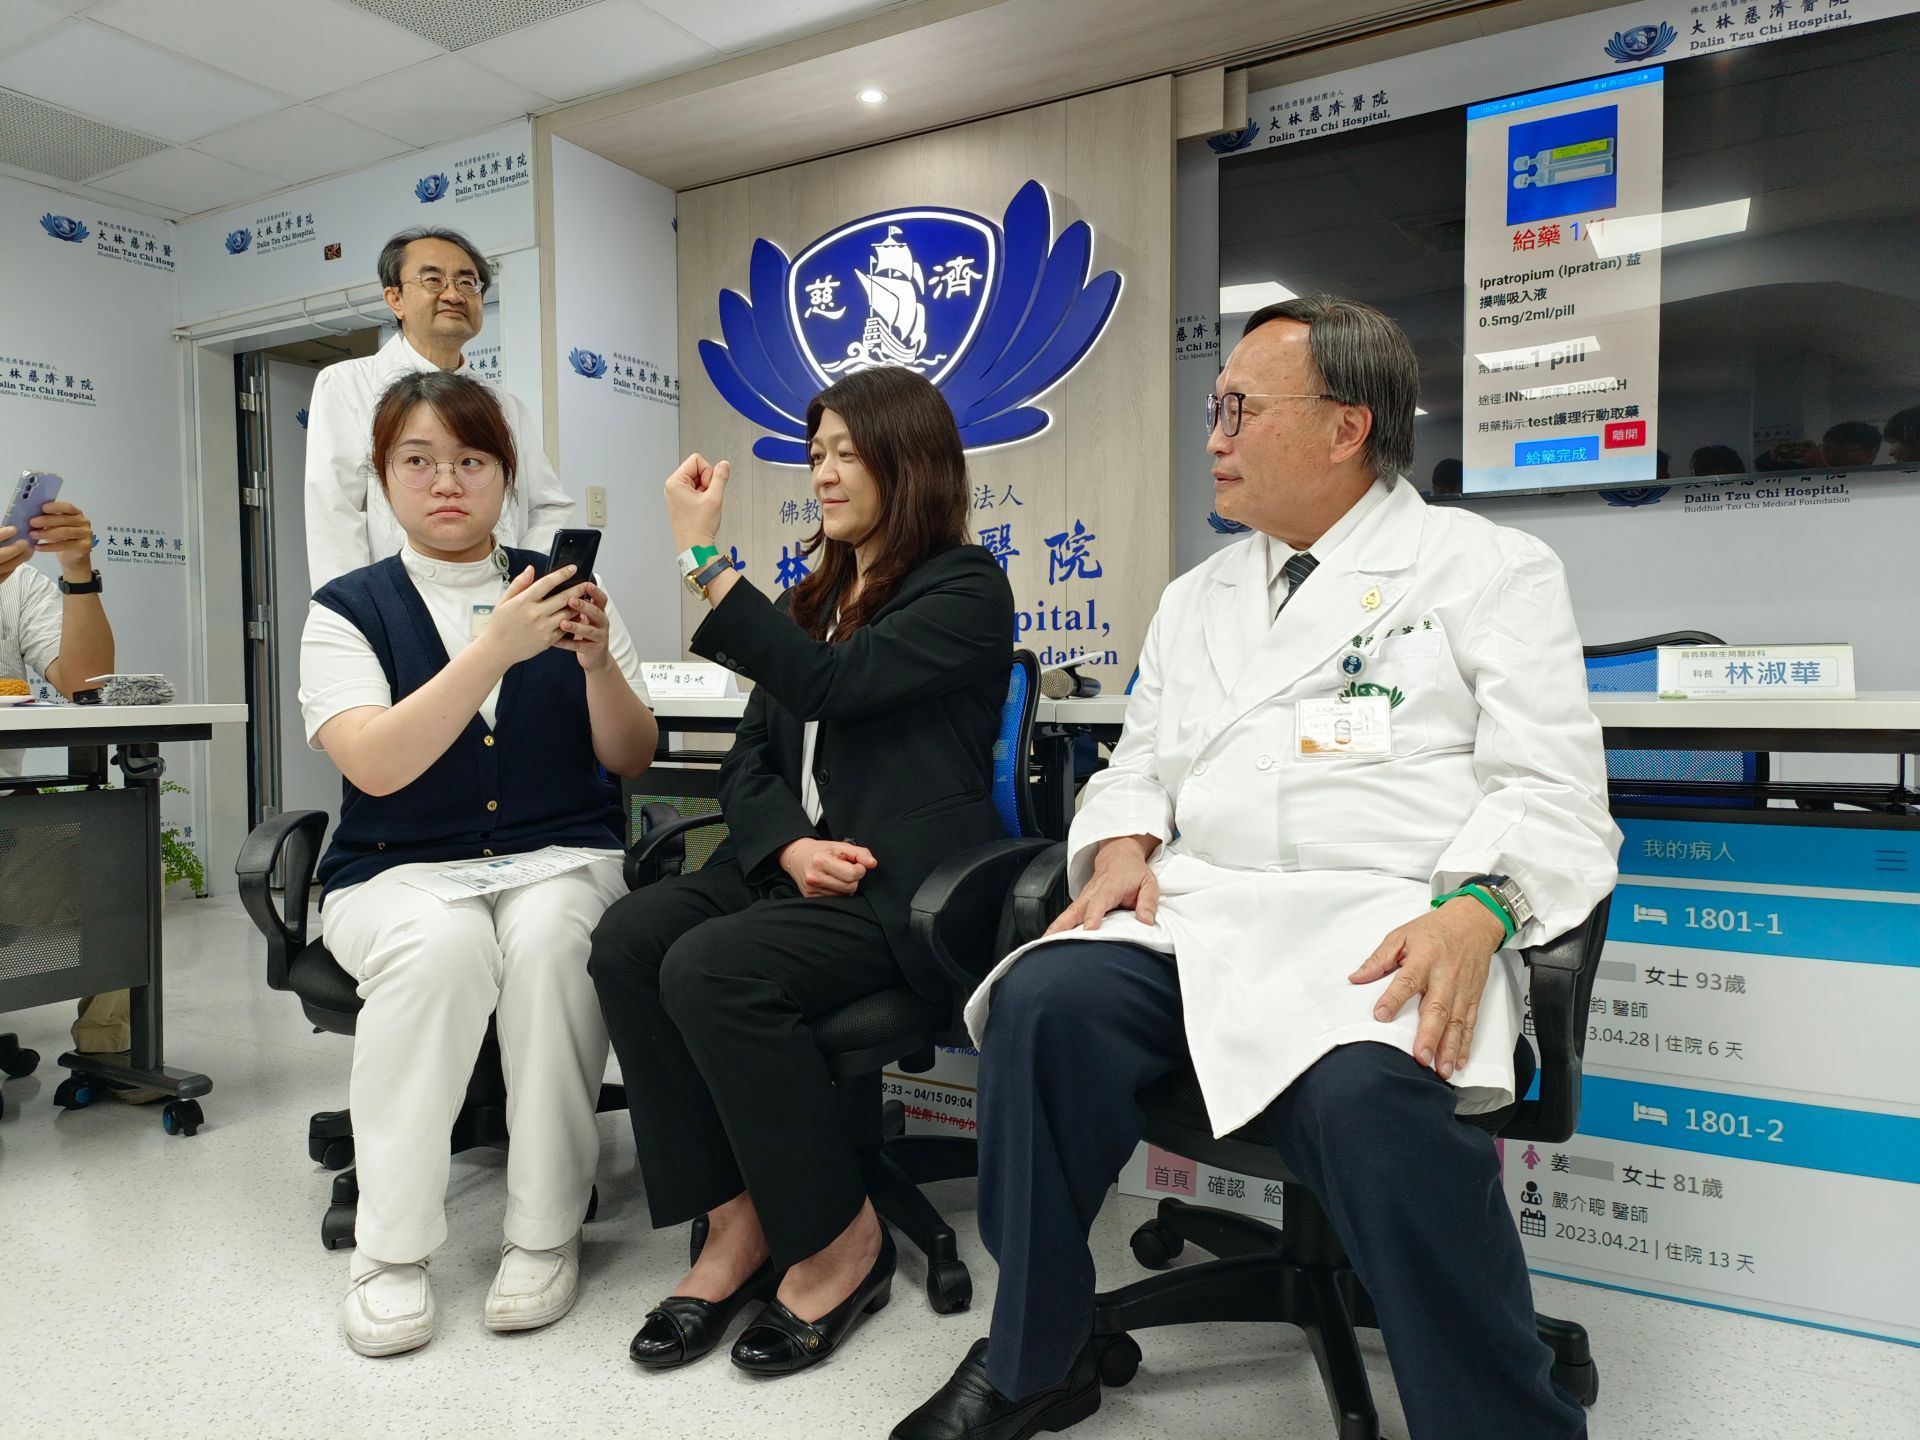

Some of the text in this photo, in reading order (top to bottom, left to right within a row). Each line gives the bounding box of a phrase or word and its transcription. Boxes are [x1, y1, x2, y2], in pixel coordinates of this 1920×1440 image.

[1690, 10, 1852, 50] Dalin Tzu Chi Hospital,
[1269, 90, 1388, 130] 大林慈濟醫院
[1269, 110, 1390, 144] Dalin Tzu Chi Hospital,
[456, 187, 472, 196] Dalin
[487, 178, 498, 187] Chi
[500, 170, 528, 182] Hospital,
[1513, 224, 1560, 252] 給藥
[98, 242, 176, 268] Dalin Tzu Chi Hosp
[1480, 252, 1641, 290] Ipratropium (Ipratran) 益
[804, 256, 982, 320] 慈 濟
[1479, 304, 1574, 328] 0.5mg/2ml/pill
[1186, 342, 1202, 352] Chi
[1550, 342, 1585, 370] pill
[0, 368, 94, 391] 林慈濟醫院
[614, 378, 630, 388] Dalin
[632, 382, 644, 392] Tzu
[646, 386, 656, 394] Chi
[19, 384, 36, 392] Tzu
[39, 386, 54, 394] Chi
[57, 390, 96, 402] Hospital,
[1612, 428, 1638, 441] 離開
[1526, 448, 1586, 465] 給藥完成
[779, 484, 1024, 526] 佛教 法人
[1684, 484, 1848, 504] Dalin Tzu Chi Hospital,
[1684, 505, 1723, 513] Buddhist
[1744, 502, 1760, 510] Chi
[1762, 500, 1796, 508] Medical
[1799, 497, 1850, 506] Foundation
[166, 553, 186, 561] Hosp
[1013, 599, 1110, 642] pital,
[1693, 661, 1820, 684] 科長 林淑華
[1642, 838, 1736, 863] 我的病人
[1684, 906, 1784, 936] 1801-1
[1645, 966, 1746, 994] 女士 93歲
[1612, 1000, 1648, 1019] 醫師
[1585, 1026, 1649, 1046] 3.04.28
[1665, 1035, 1702, 1055] 住院
[1708, 1042, 1718, 1056] 6
[1724, 1042, 1744, 1060] 天
[914, 1088, 942, 1102] 04/15
[945, 1094, 972, 1108] 09:04
[1684, 1108, 1784, 1142] 1801-2
[1154, 1166, 1283, 1204] 首頁 確認 給
[1551, 1153, 1723, 1200] 姜 女士 81歲
[1612, 1202, 1648, 1224] 醫師
[1555, 1223, 1649, 1254] 2023.04.21
[1665, 1242, 1702, 1264] 住院
[1708, 1251, 1730, 1268] 13
[1736, 1254, 1755, 1274] 天
